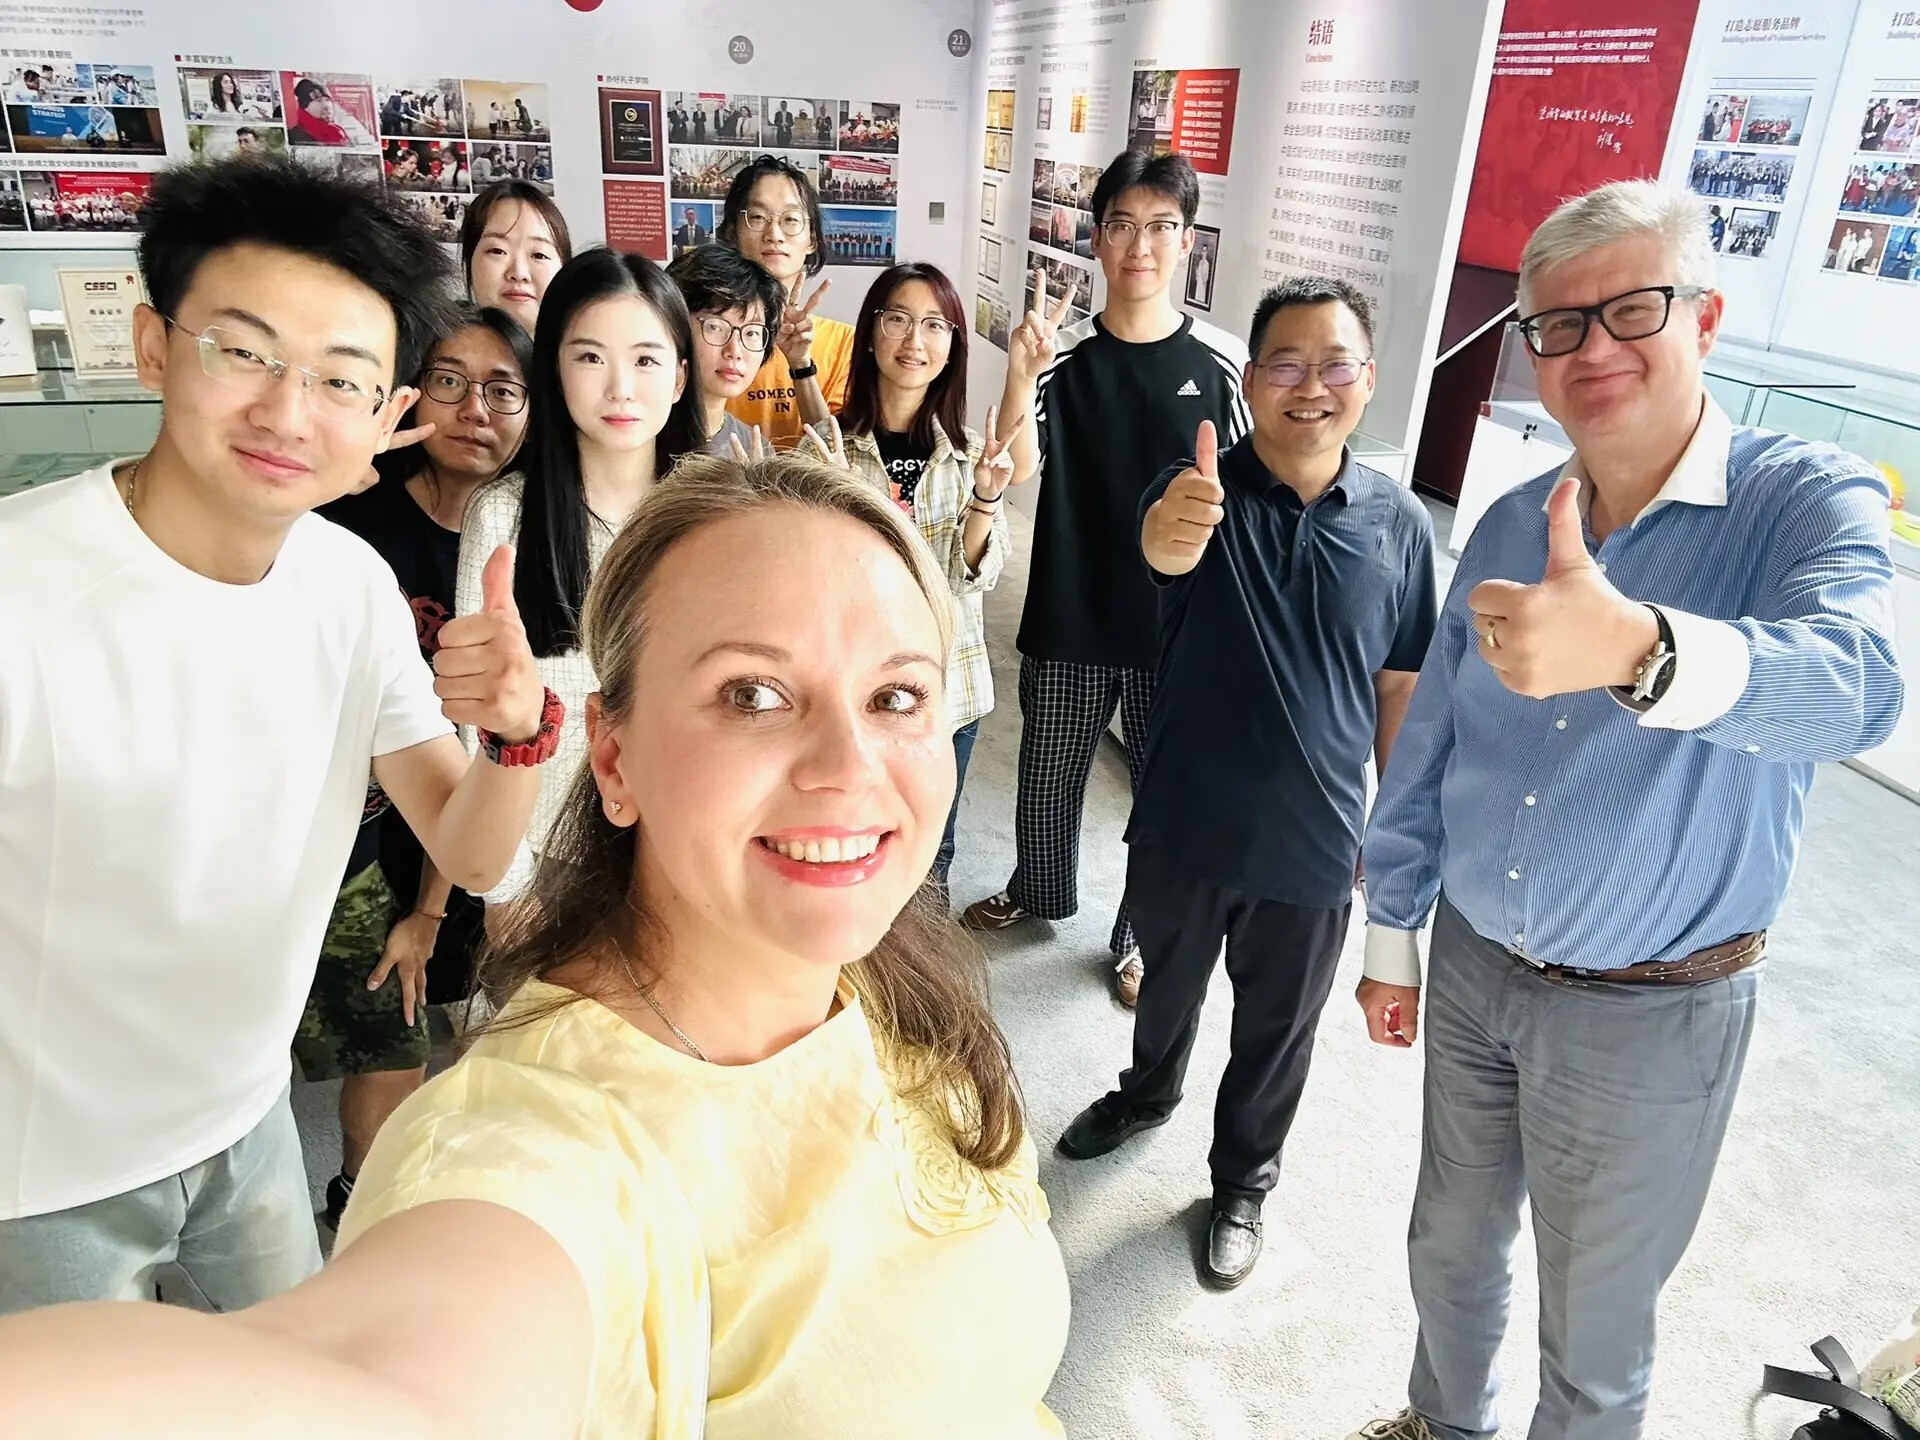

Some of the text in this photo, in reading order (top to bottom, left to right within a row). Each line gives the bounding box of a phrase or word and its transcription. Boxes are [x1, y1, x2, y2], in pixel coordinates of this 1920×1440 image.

[1309, 19, 1335, 46] 结语
[1725, 16, 1801, 33] 打造志愿服务品牌
[775, 402, 790, 413] IN
